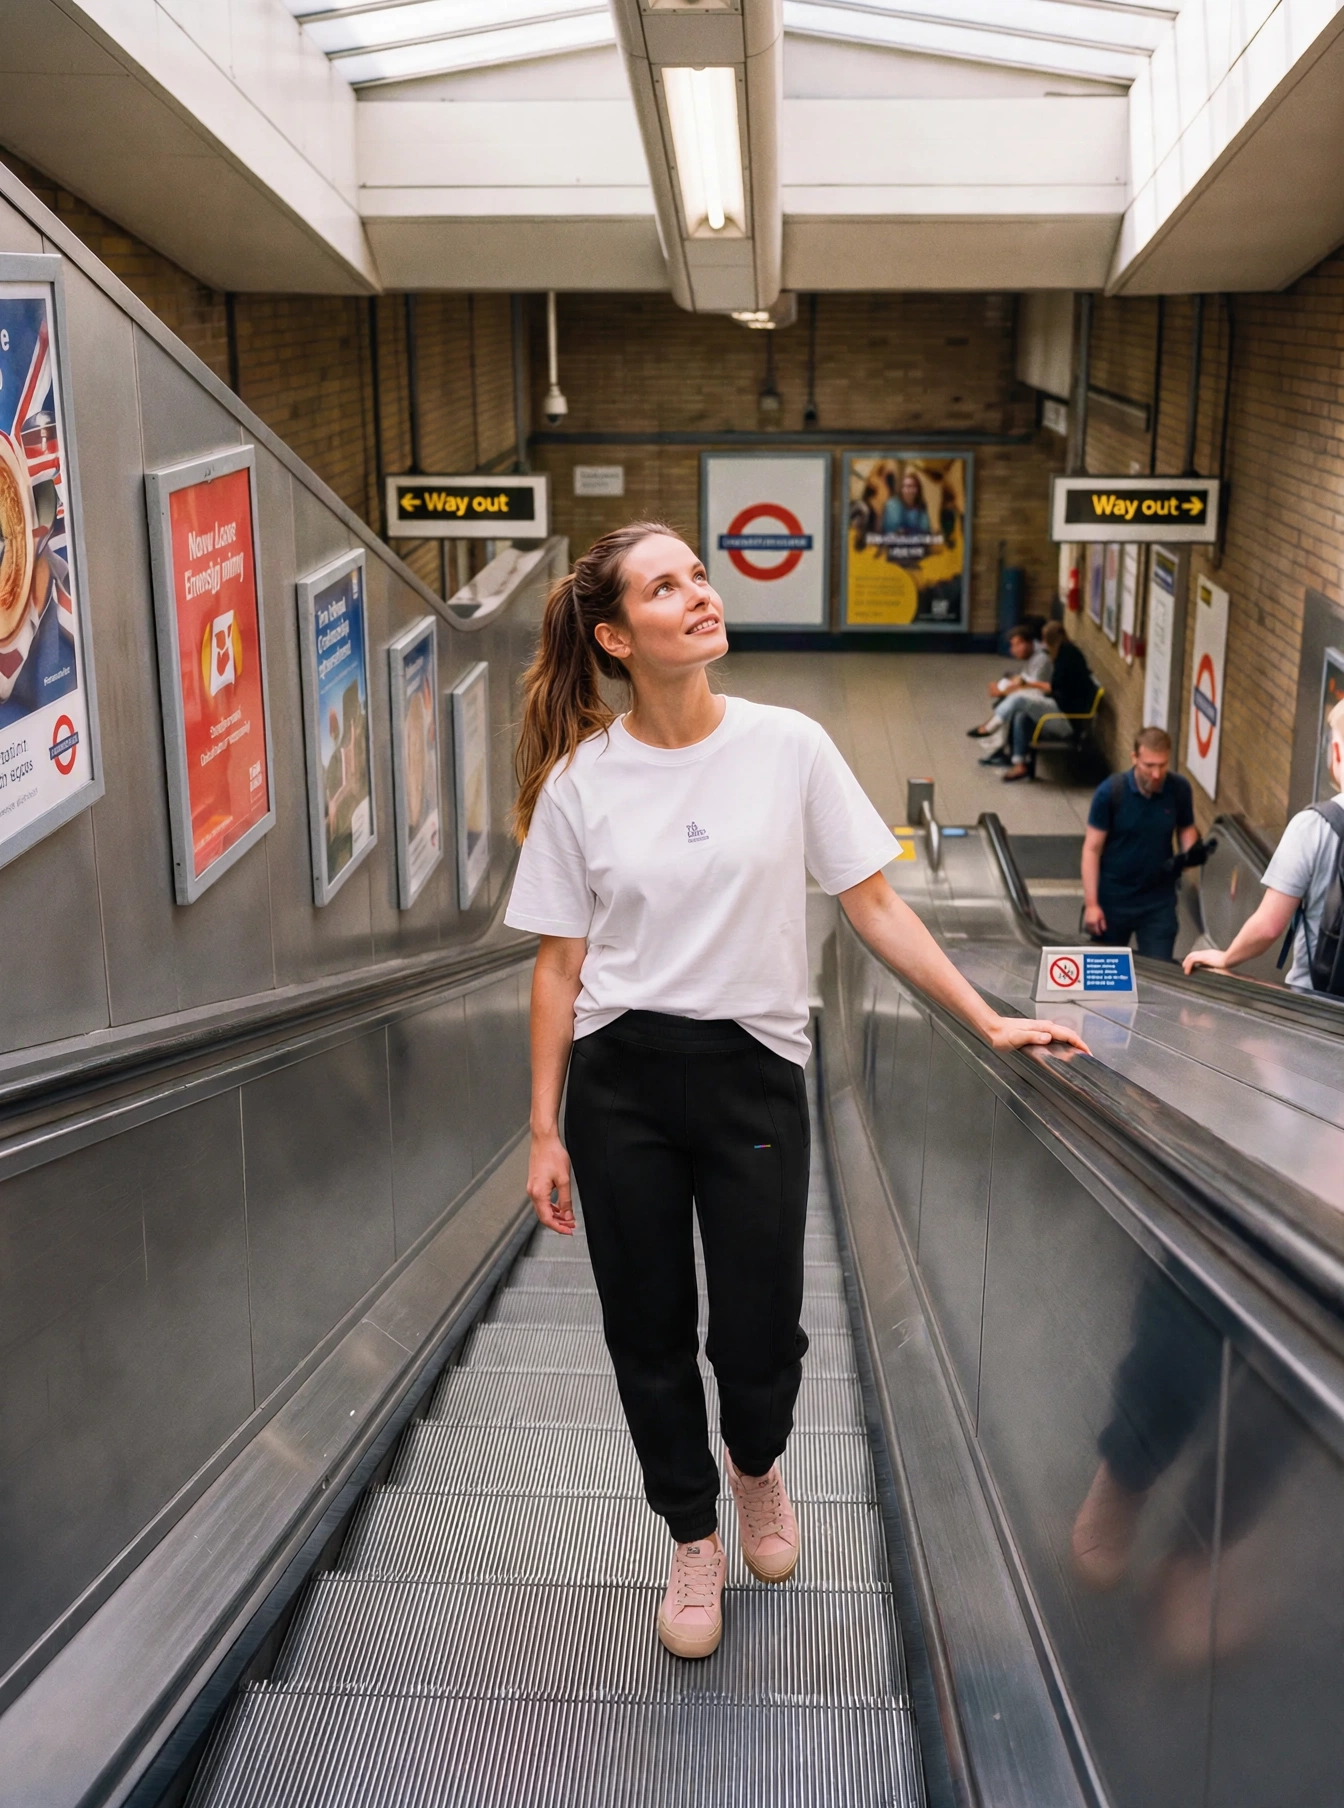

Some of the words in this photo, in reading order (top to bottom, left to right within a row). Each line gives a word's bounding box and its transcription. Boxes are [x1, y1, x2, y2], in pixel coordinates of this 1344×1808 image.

[424, 492, 469, 517] Way
[472, 493, 509, 513] out
[1092, 494, 1139, 520] Way
[1141, 496, 1179, 516] out
